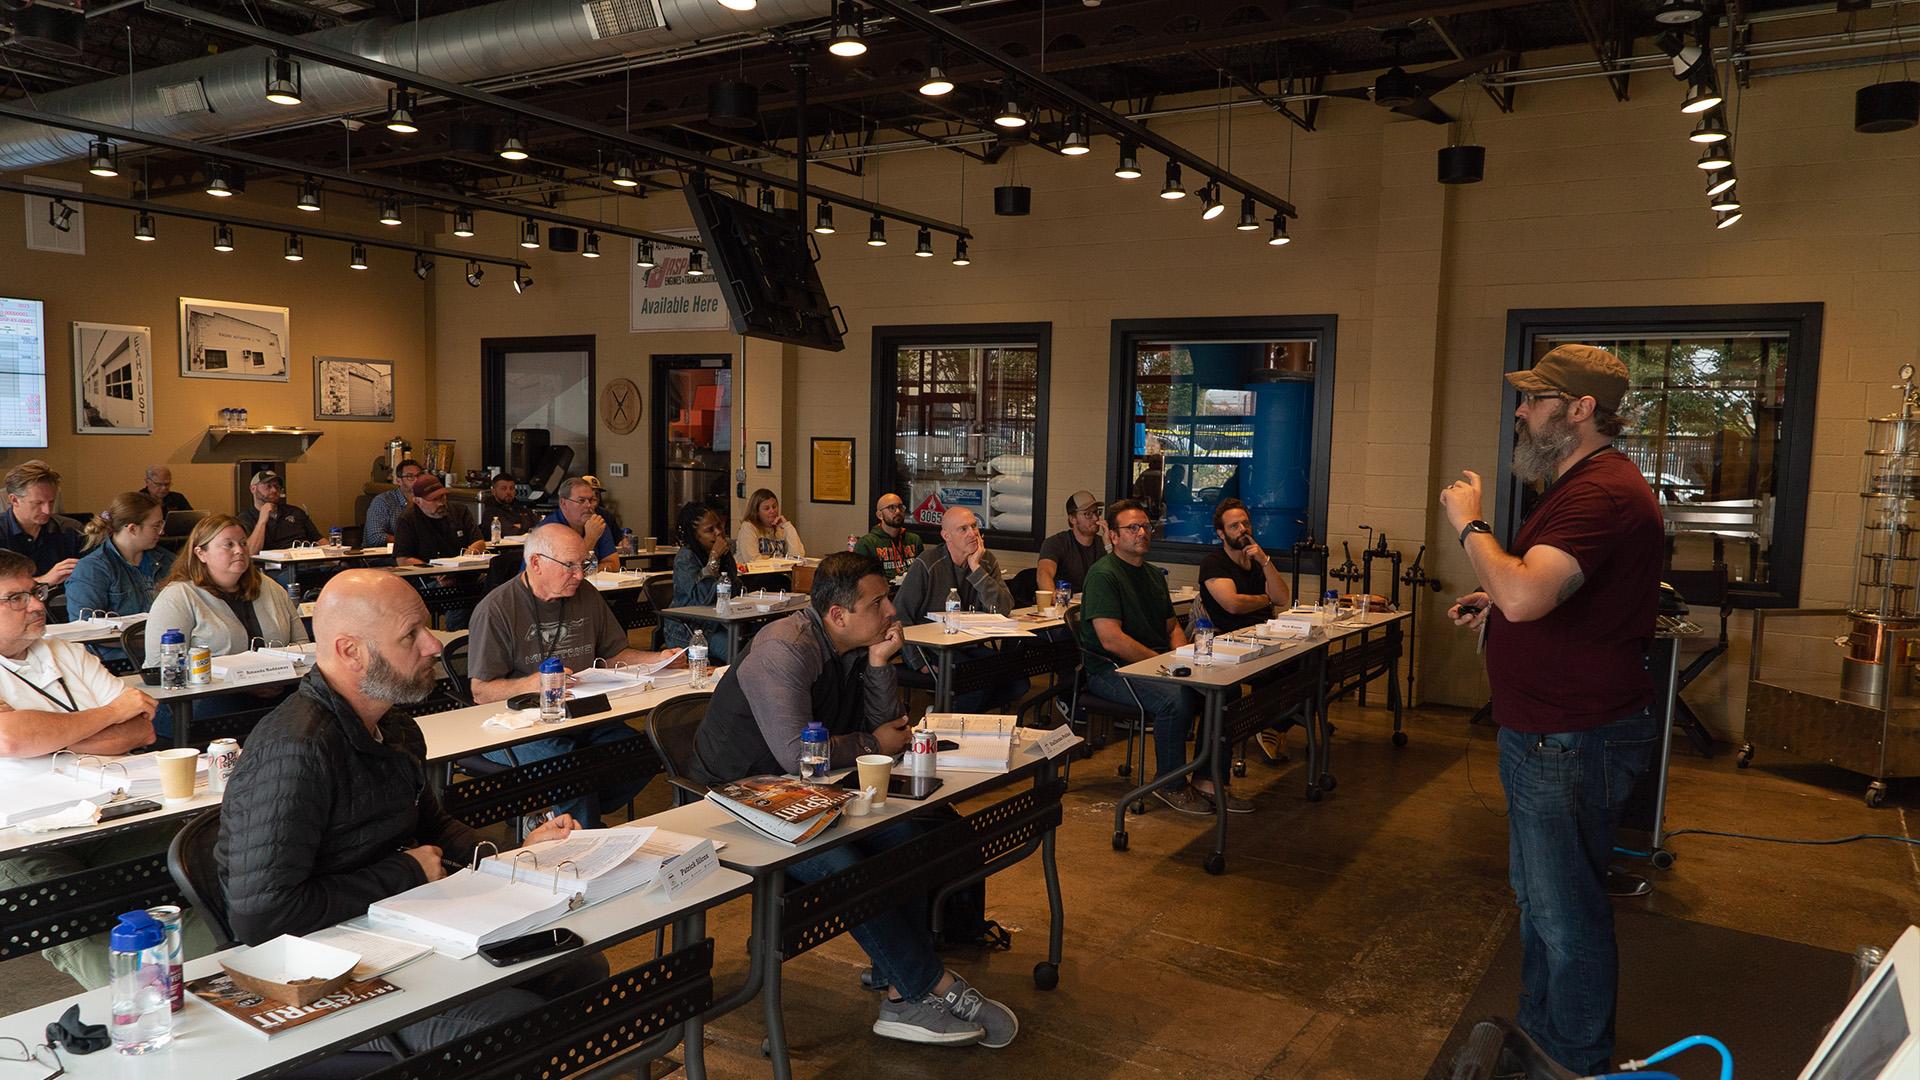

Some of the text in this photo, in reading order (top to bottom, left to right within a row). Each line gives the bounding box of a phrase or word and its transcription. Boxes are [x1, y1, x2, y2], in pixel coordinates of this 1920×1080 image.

[641, 295, 718, 314] Available Here
[134, 336, 145, 422] EXHAUST
[921, 511, 942, 523] 3065
[775, 795, 829, 820] SPIRIT
